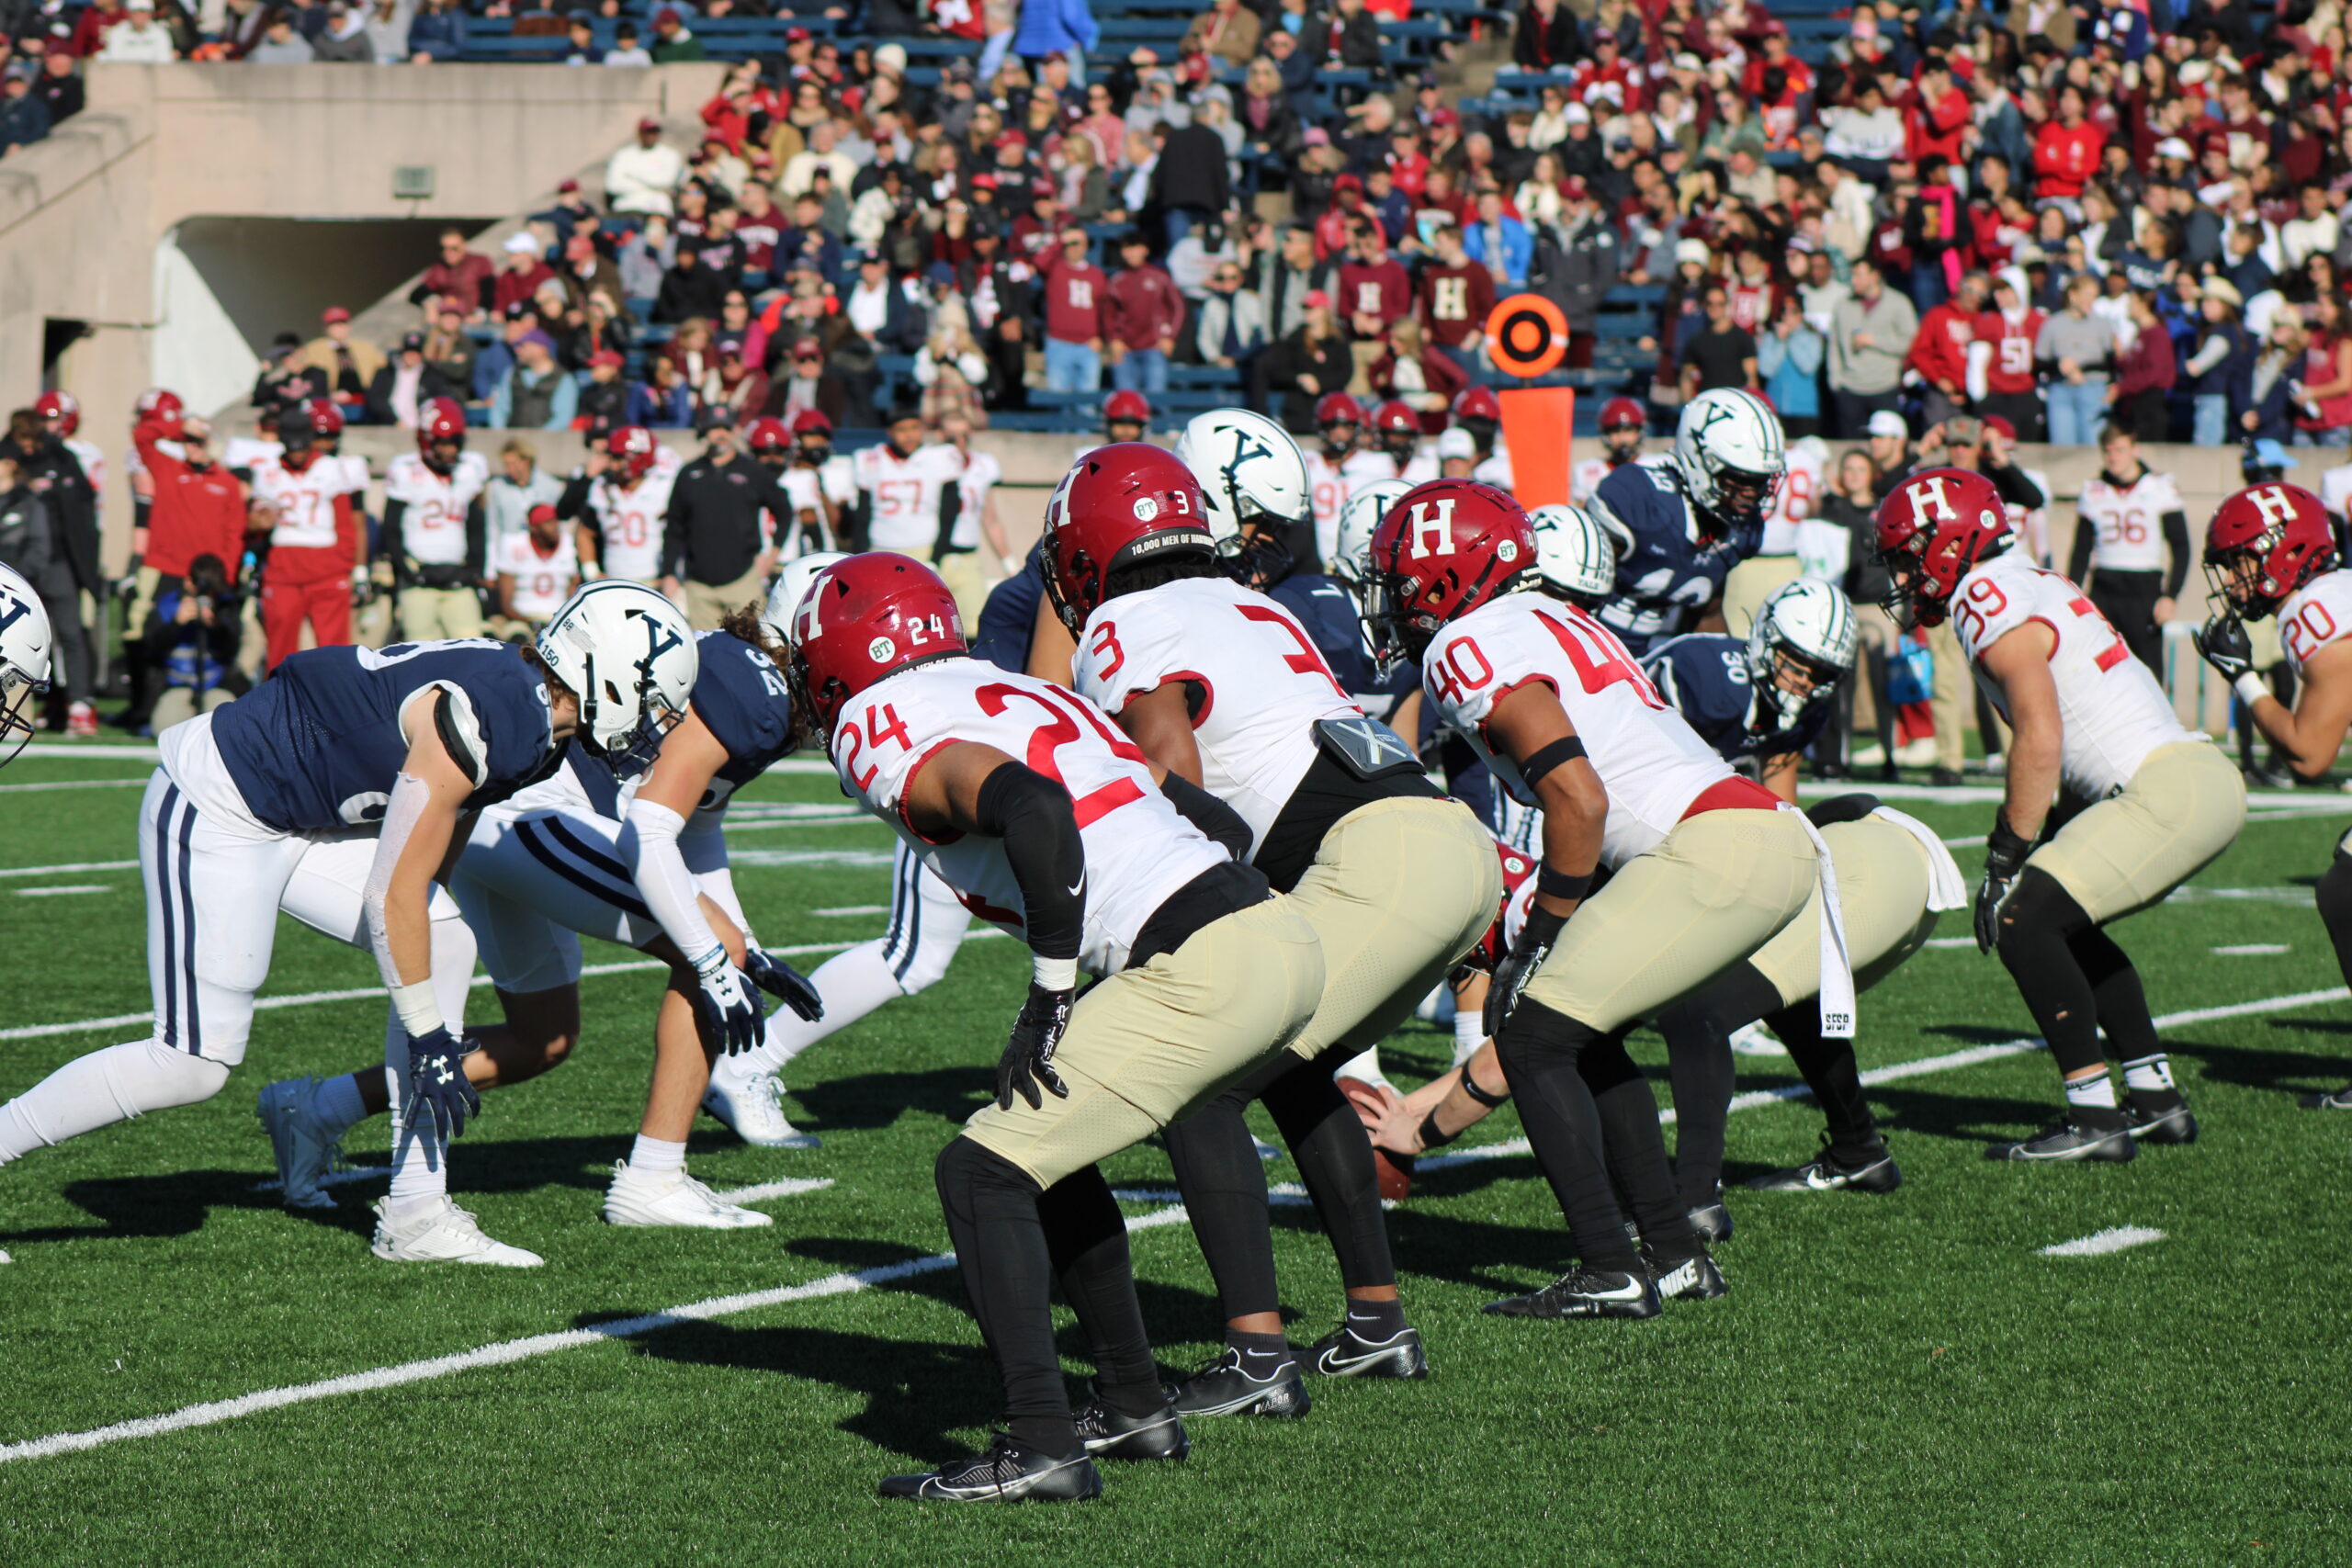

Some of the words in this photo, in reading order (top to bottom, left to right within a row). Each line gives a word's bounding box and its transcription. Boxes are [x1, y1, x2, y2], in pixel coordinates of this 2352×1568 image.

[1434, 277, 1467, 320] H
[1690, 401, 1734, 454] Y
[1219, 427, 1273, 479] Y
[277, 490, 319, 527] 27
[422, 499, 464, 529] 24
[878, 479, 922, 515] 57
[1045, 466, 1084, 535] H
[1136, 502, 1154, 517] BT
[1174, 491, 1190, 514] 3
[1905, 477, 1957, 528] H
[2246, 486, 2297, 527] H
[1131, 539, 1160, 556] 10,000
[1162, 535, 1179, 547] MEN
[1181, 534, 1190, 544] OF
[1410, 499, 1455, 559] H
[2101, 509, 2146, 544] 36
[1499, 544, 1515, 558] BT
[1577, 579, 1600, 590] YALE
[563, 618, 574, 631] 88
[791, 574, 834, 648] H
[907, 614, 944, 646] 24
[1953, 577, 2007, 644] 39
[2283, 600, 2336, 661] 20
[541, 643, 559, 667] 150
[633, 613, 684, 677] Y
[870, 639, 891, 660] BT
[1091, 621, 1125, 682] 3
[745, 648, 788, 695] 32
[1428, 636, 1494, 705] 40
[1721, 651, 1749, 684] 30
[839, 703, 913, 793] 24
[1657, 1258, 1699, 1298] NIKE
